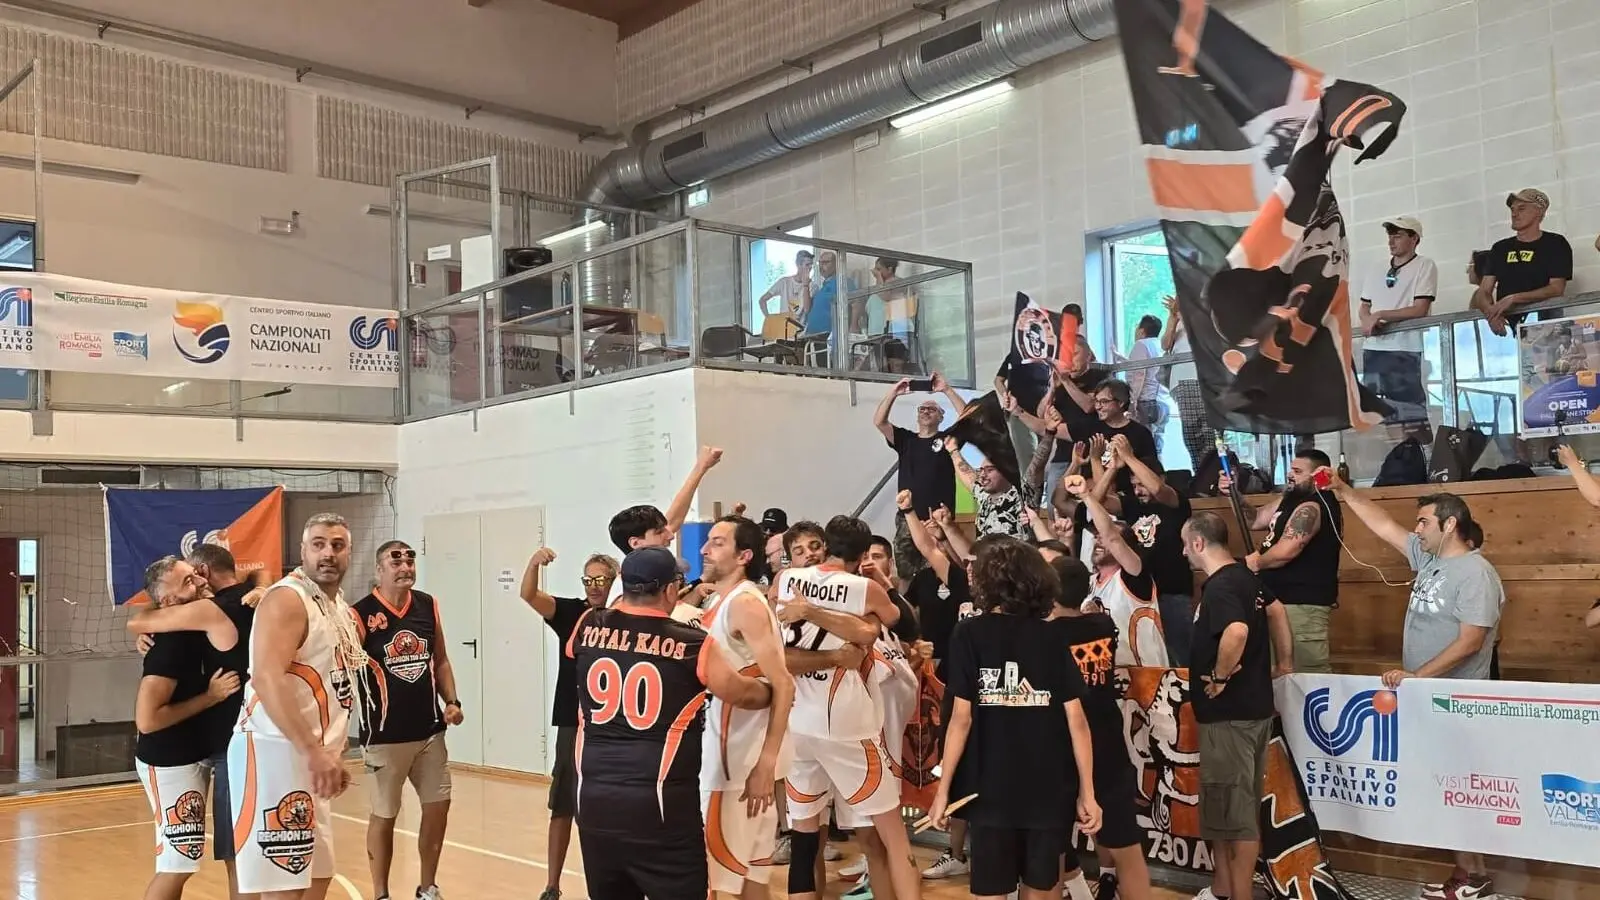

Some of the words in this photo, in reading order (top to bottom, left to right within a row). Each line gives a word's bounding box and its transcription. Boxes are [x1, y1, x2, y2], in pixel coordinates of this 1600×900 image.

[66, 294, 93, 304] Regione
[275, 309, 304, 317] SPORTIVO
[250, 323, 331, 341] CAMPIONATI
[60, 340, 102, 350] ROMAGNA
[114, 338, 145, 349] SPORT
[250, 339, 321, 354] NAZIONALI
[350, 352, 399, 361] CENTRO
[350, 358, 399, 367] SPORTIVO
[350, 365, 399, 373] ITALIANO
[1548, 398, 1588, 412] OPEN
[581, 625, 631, 652] TOTAL
[633, 632, 687, 660] KAOS
[586, 657, 663, 731] 90
[1451, 699, 1499, 718] Regione
[1306, 760, 1398, 781] CENTRO
[1306, 773, 1397, 795] SPORTIVO
[1307, 785, 1397, 808] ITALIANO
[1444, 790, 1521, 810] ROMAGNA
[1498, 816, 1521, 826] ITALY
[1147, 830, 1189, 867] 730
[1191, 840, 1215, 871] A
